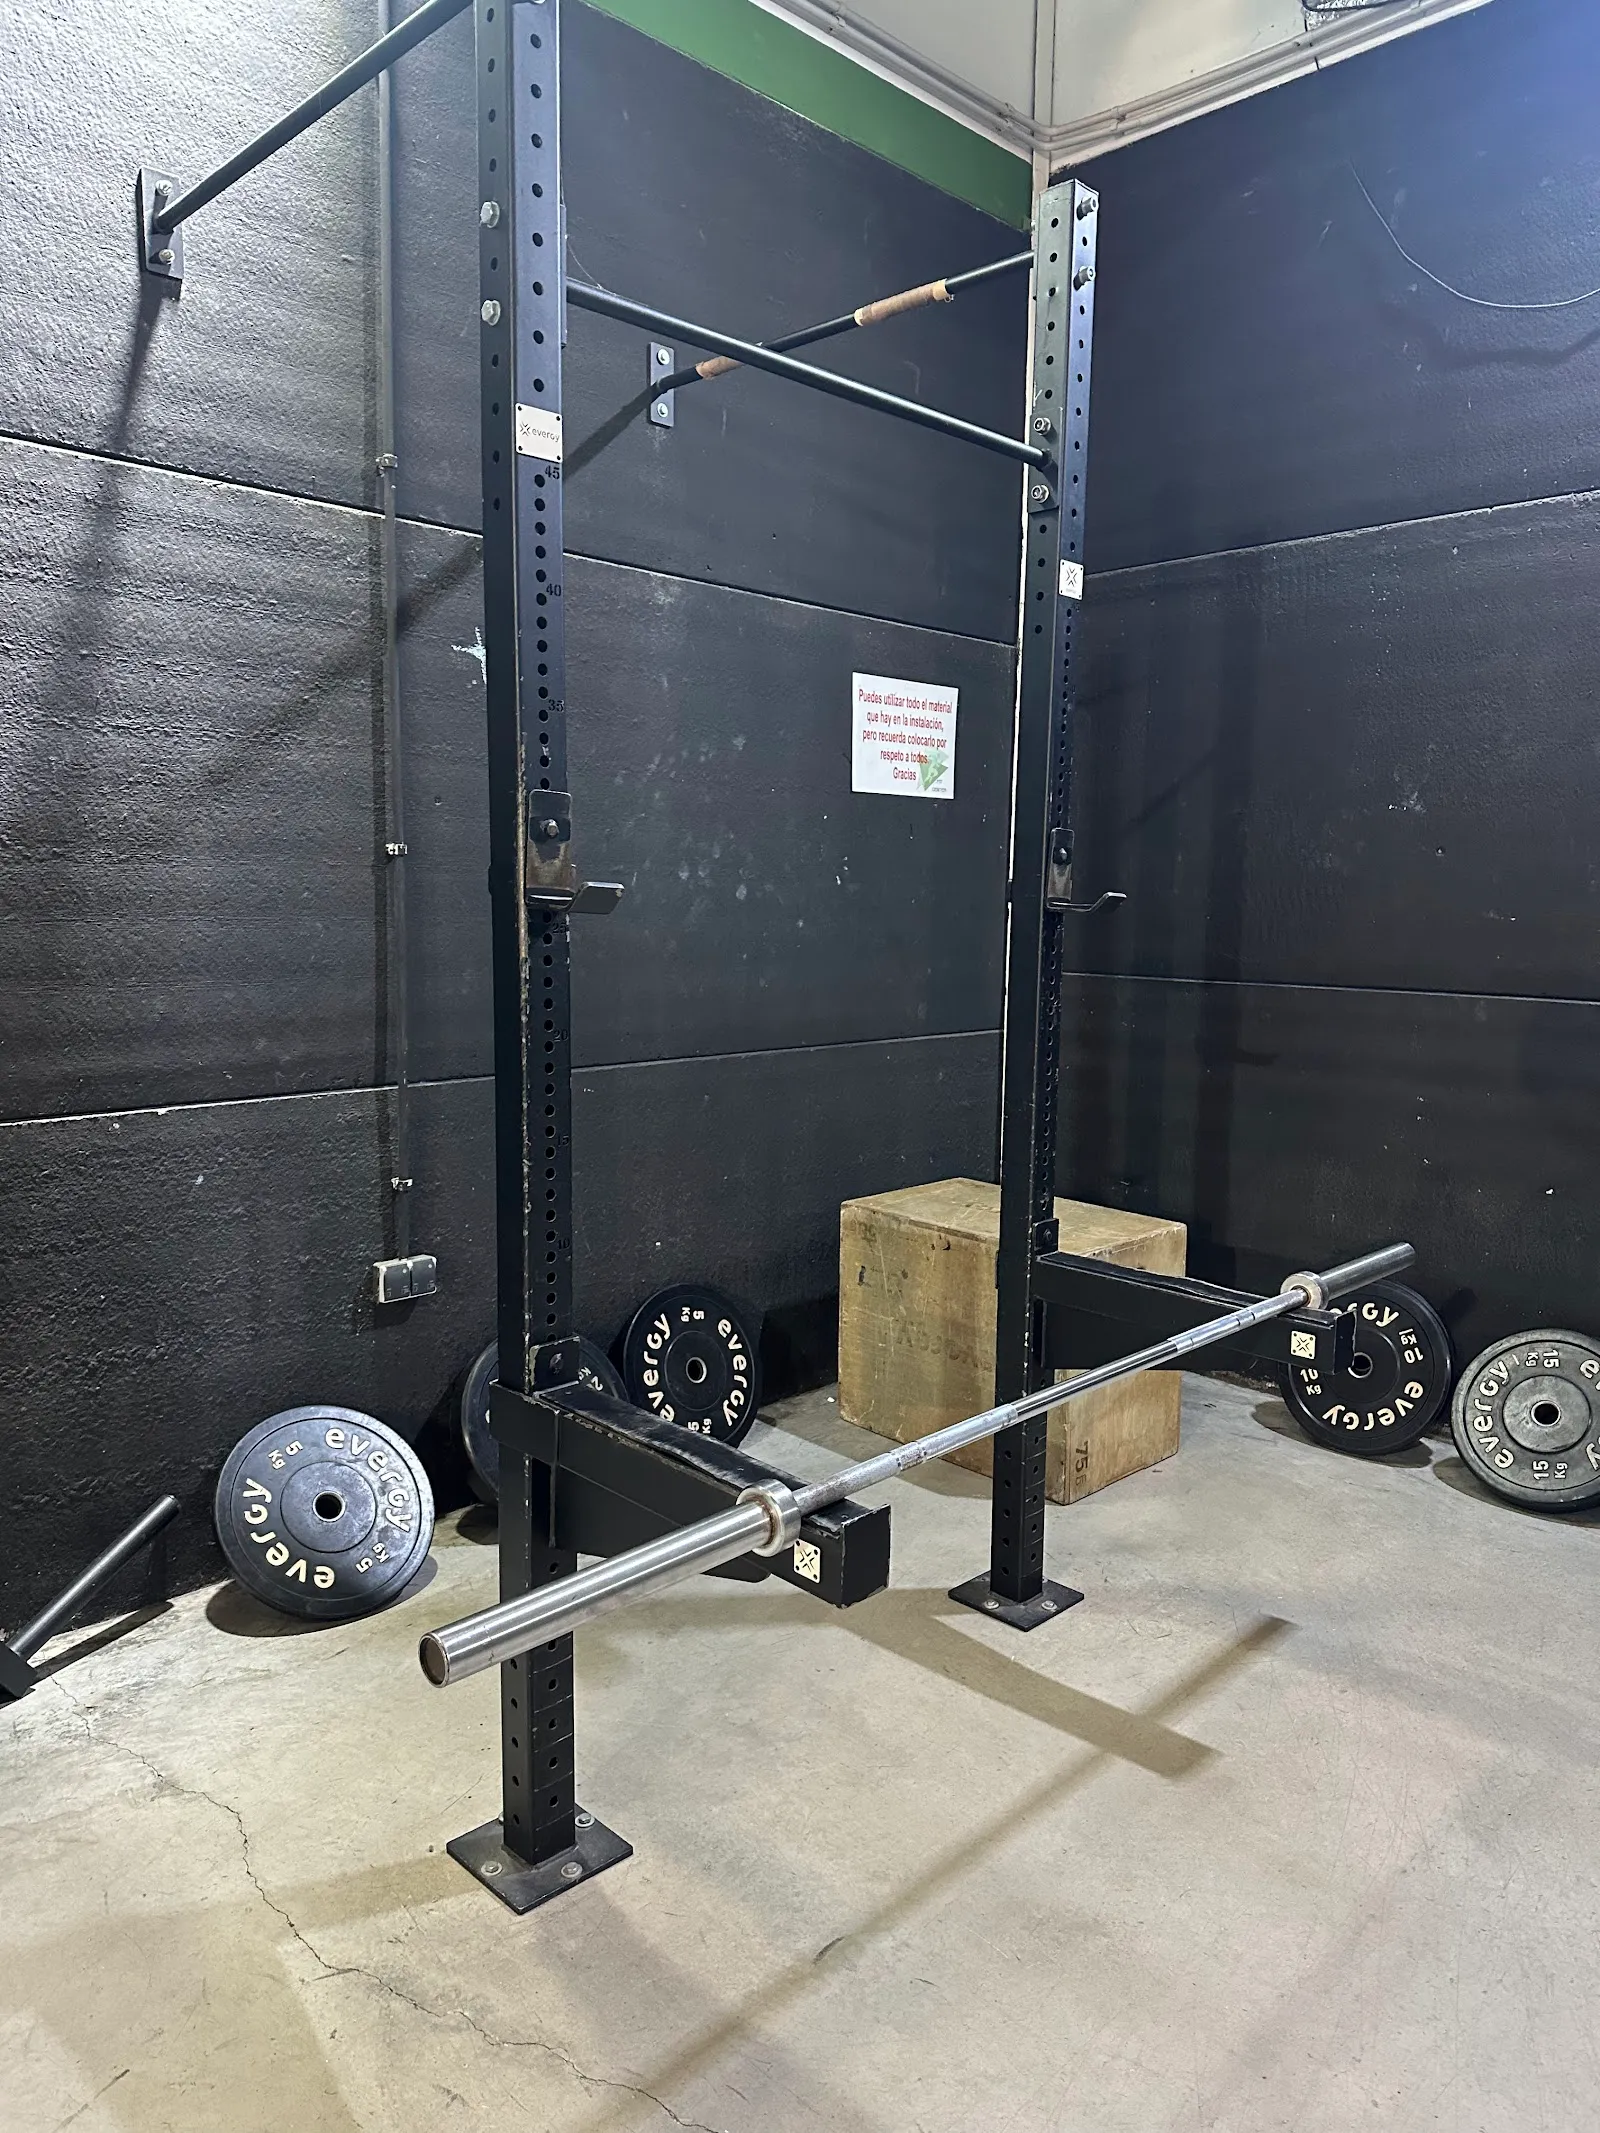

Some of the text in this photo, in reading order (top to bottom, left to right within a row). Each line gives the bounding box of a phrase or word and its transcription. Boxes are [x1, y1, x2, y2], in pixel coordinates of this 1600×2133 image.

[544, 465, 560, 480] 45
[546, 583, 562, 597] 40
[548, 699, 564, 712] 35
[858, 688, 882, 704] Puedes
[906, 696, 920, 709] todo
[921, 698, 927, 710] el
[928, 701, 953, 714] material
[867, 710, 944, 732] que hay en la instalación,
[862, 730, 947, 750] pero recuerda colocarlo por
[880, 750, 904, 763] respeto
[905, 752, 910, 762] a
[892, 767, 917, 781] Gracias
[553, 1029, 568, 1041] 20
[693, 1310, 705, 1320] 5
[1404, 1347, 1424, 1363] 10
[1543, 1350, 1560, 1368] 15
[1300, 1368, 1319, 1382] 10
[688, 1421, 700, 1432] 5
[285, 1440, 303, 1456] 5
[1533, 1460, 1550, 1480] 15
[355, 1557, 373, 1574] 5
